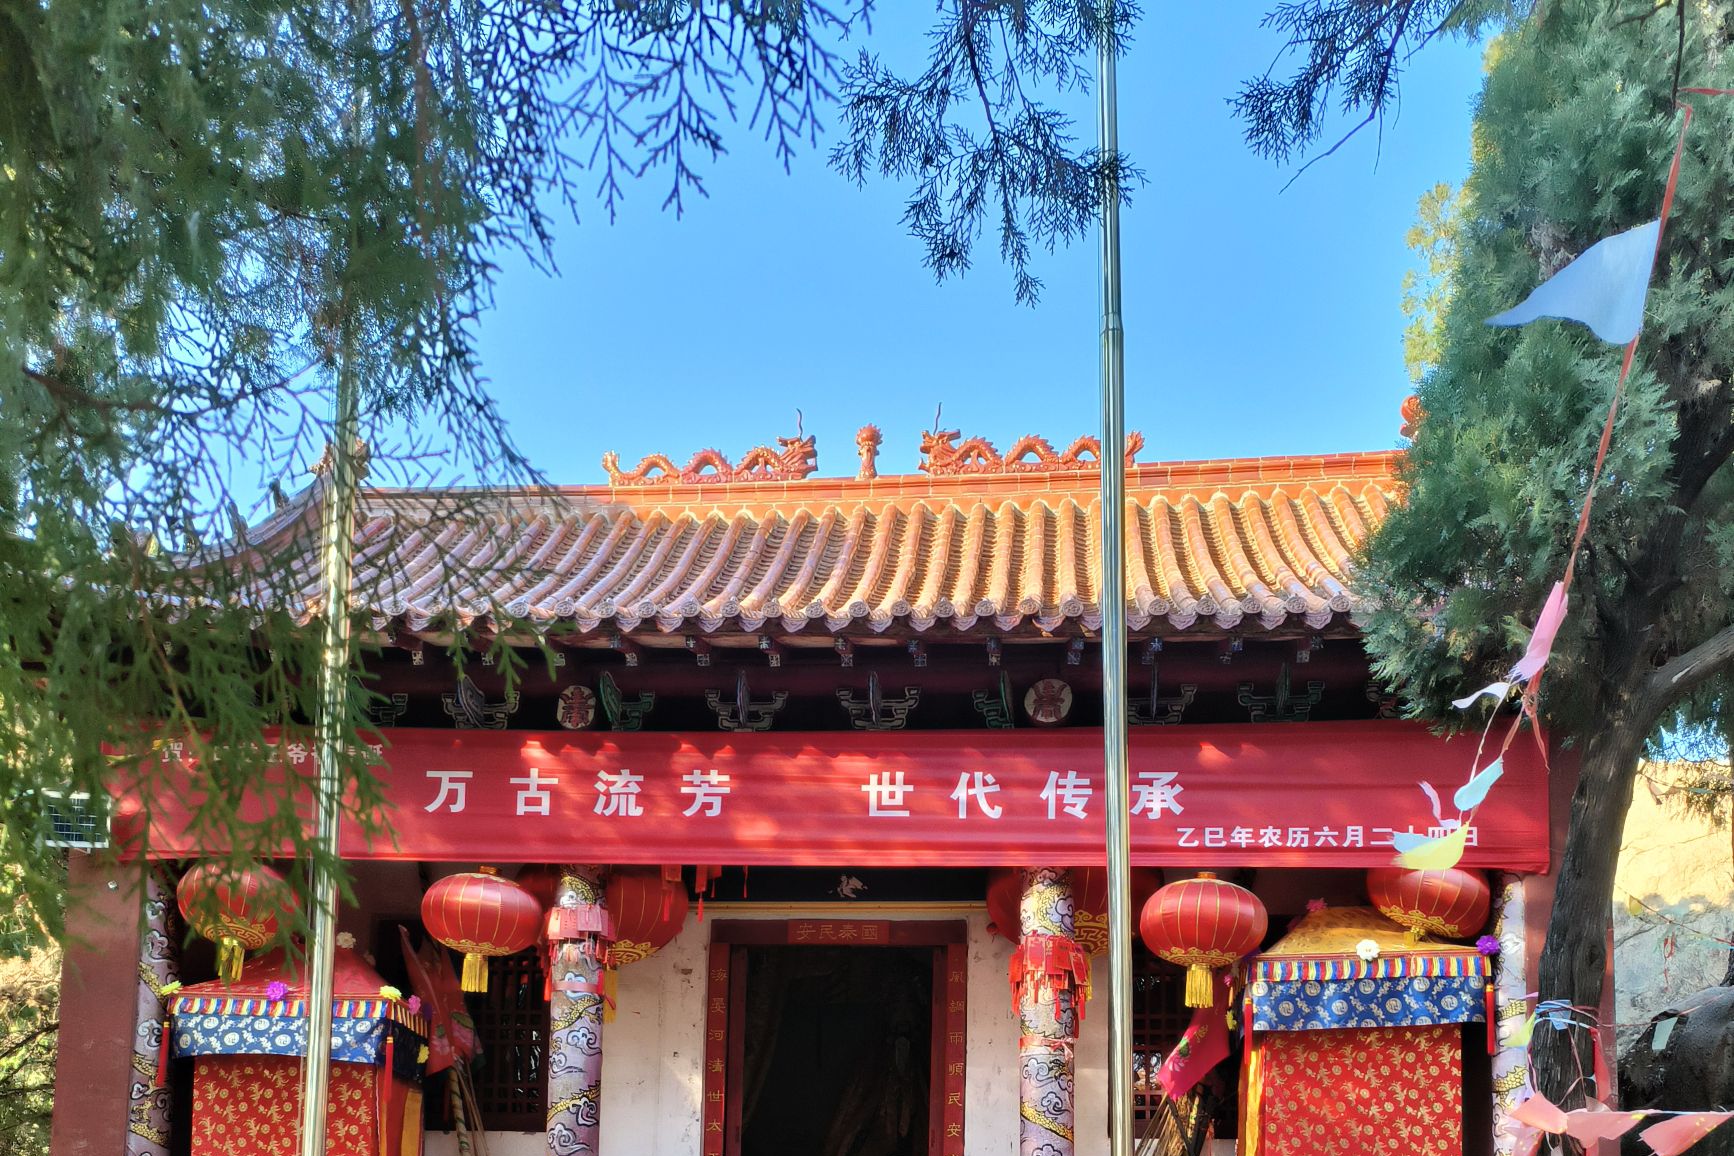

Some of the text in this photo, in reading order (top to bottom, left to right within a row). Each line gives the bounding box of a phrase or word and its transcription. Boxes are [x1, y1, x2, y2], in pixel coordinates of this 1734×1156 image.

[424, 768, 1186, 820] 万古流芳 世代传承
